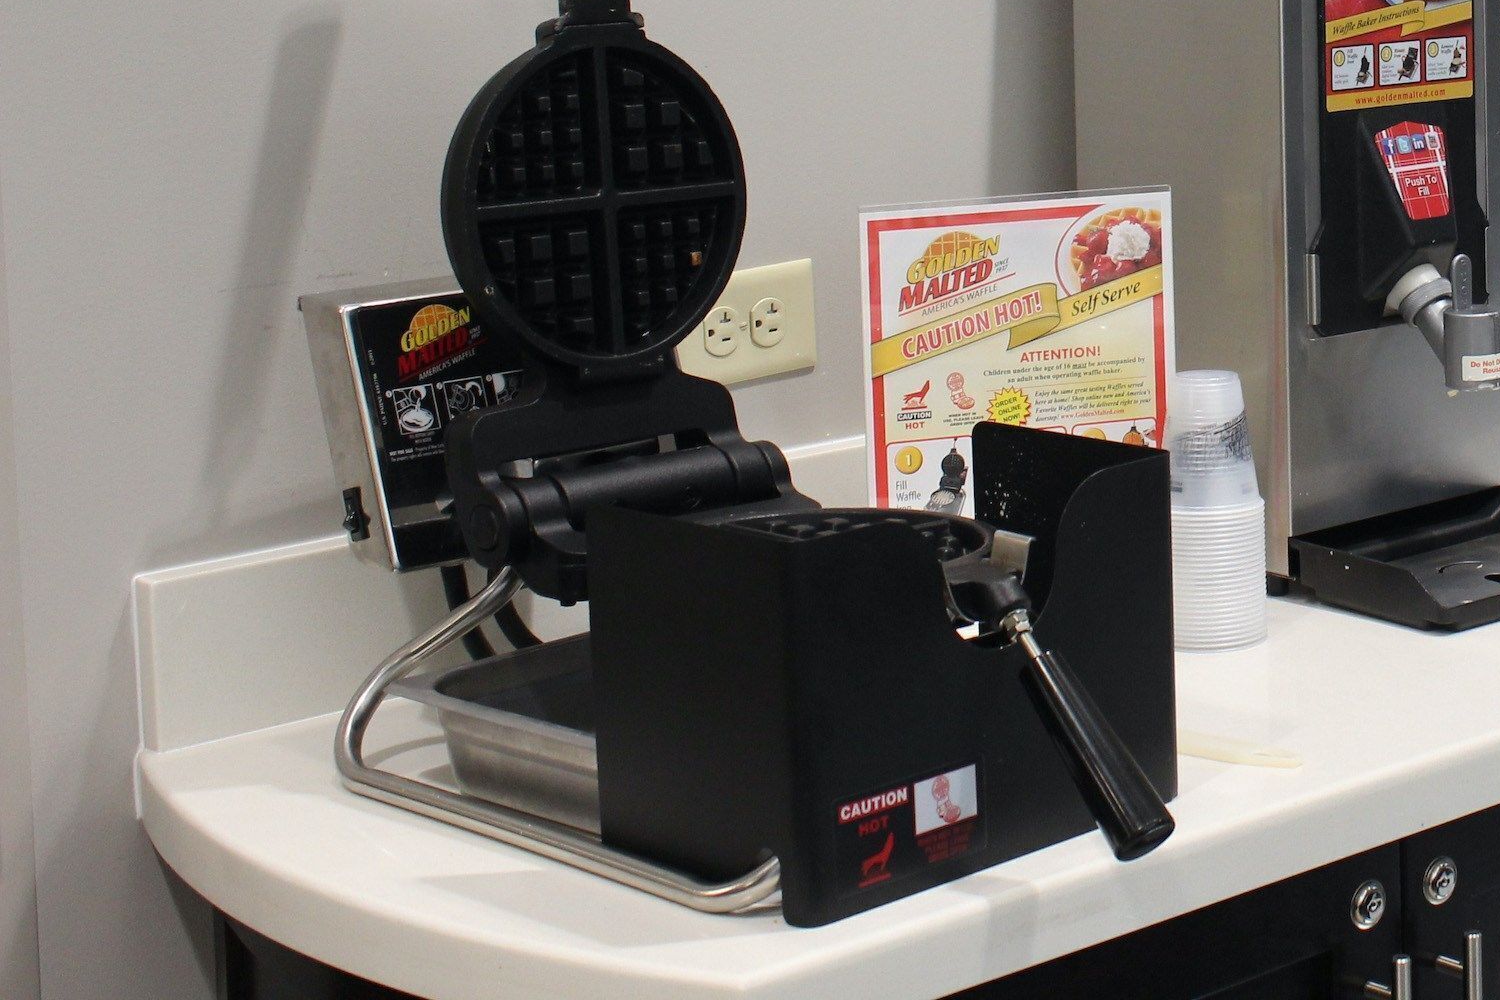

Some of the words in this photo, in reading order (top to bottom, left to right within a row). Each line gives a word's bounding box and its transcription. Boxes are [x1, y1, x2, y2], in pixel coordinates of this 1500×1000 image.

[1332, 21, 1357, 37] Waffle
[1356, 16, 1377, 30] Baker
[1378, 6, 1421, 25] Instructions
[1355, 89, 1446, 106] www.goldenmalted.com
[1405, 175, 1426, 188] Push
[1427, 174, 1438, 184] To
[1418, 186, 1431, 197] Fill
[906, 233, 1001, 285] GOLDEN
[898, 257, 994, 313] MALTED
[921, 294, 966, 317] AMERICA'S
[966, 284, 998, 301] WAFFLE
[1071, 293, 1100, 317] Self
[1100, 281, 1142, 306] Serve
[400, 305, 471, 353] GOLDEN
[901, 312, 991, 360] CAUTION
[994, 290, 1043, 327] HOT!
[398, 325, 469, 376] MALTED
[1020, 346, 1101, 363] ATTENTION!
[418, 358, 453, 381] AMERICA'S
[452, 348, 477, 366] WAFFLE
[983, 368, 1013, 377] Children
[1013, 366, 1033, 375] under
[1033, 365, 1043, 373] the
[1044, 365, 1055, 374] age
[1055, 363, 1063, 371] of
[1063, 362, 1071, 370] 16
[1097, 357, 1137, 368] accompanied
[1137, 356, 1146, 365] by
[1017, 375, 1034, 383] adult
[1034, 373, 1052, 381] when
[1052, 371, 1083, 382] operating
[1083, 368, 1102, 377] waffle
[1103, 367, 1123, 376] baker.
[994, 396, 1018, 409] ORDER
[1034, 390, 1051, 398] Enjoy
[897, 411, 932, 421] CAUTION
[998, 404, 1021, 416] ONLINE
[1003, 413, 1021, 423] NOW!
[905, 421, 926, 430] HOT
[906, 453, 912, 467] 1
[895, 480, 908, 491] Fill
[896, 490, 922, 502] Waffle
[839, 786, 909, 822] CAUTION
[857, 816, 890, 838] HOT
